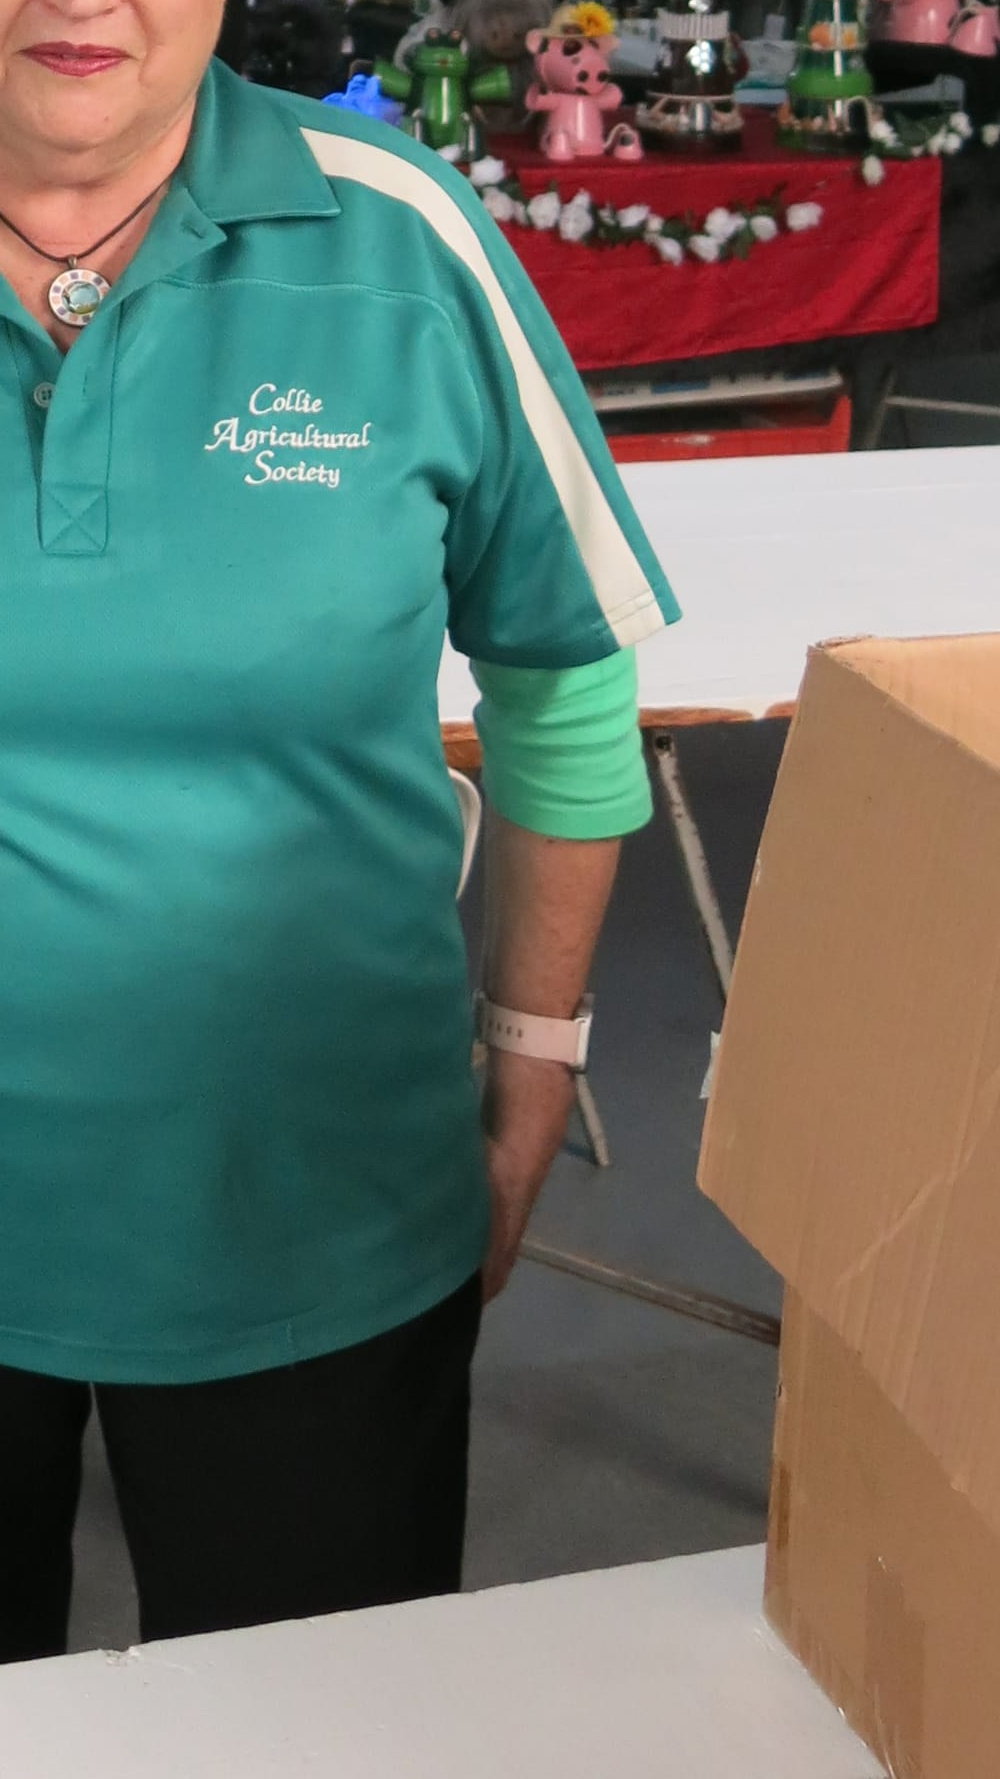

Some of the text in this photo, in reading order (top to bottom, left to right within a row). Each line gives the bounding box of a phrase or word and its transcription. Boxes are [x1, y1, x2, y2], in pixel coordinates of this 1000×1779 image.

[249, 382, 324, 416] Collie
[203, 416, 373, 453] Agricultural
[244, 449, 341, 489] Society
